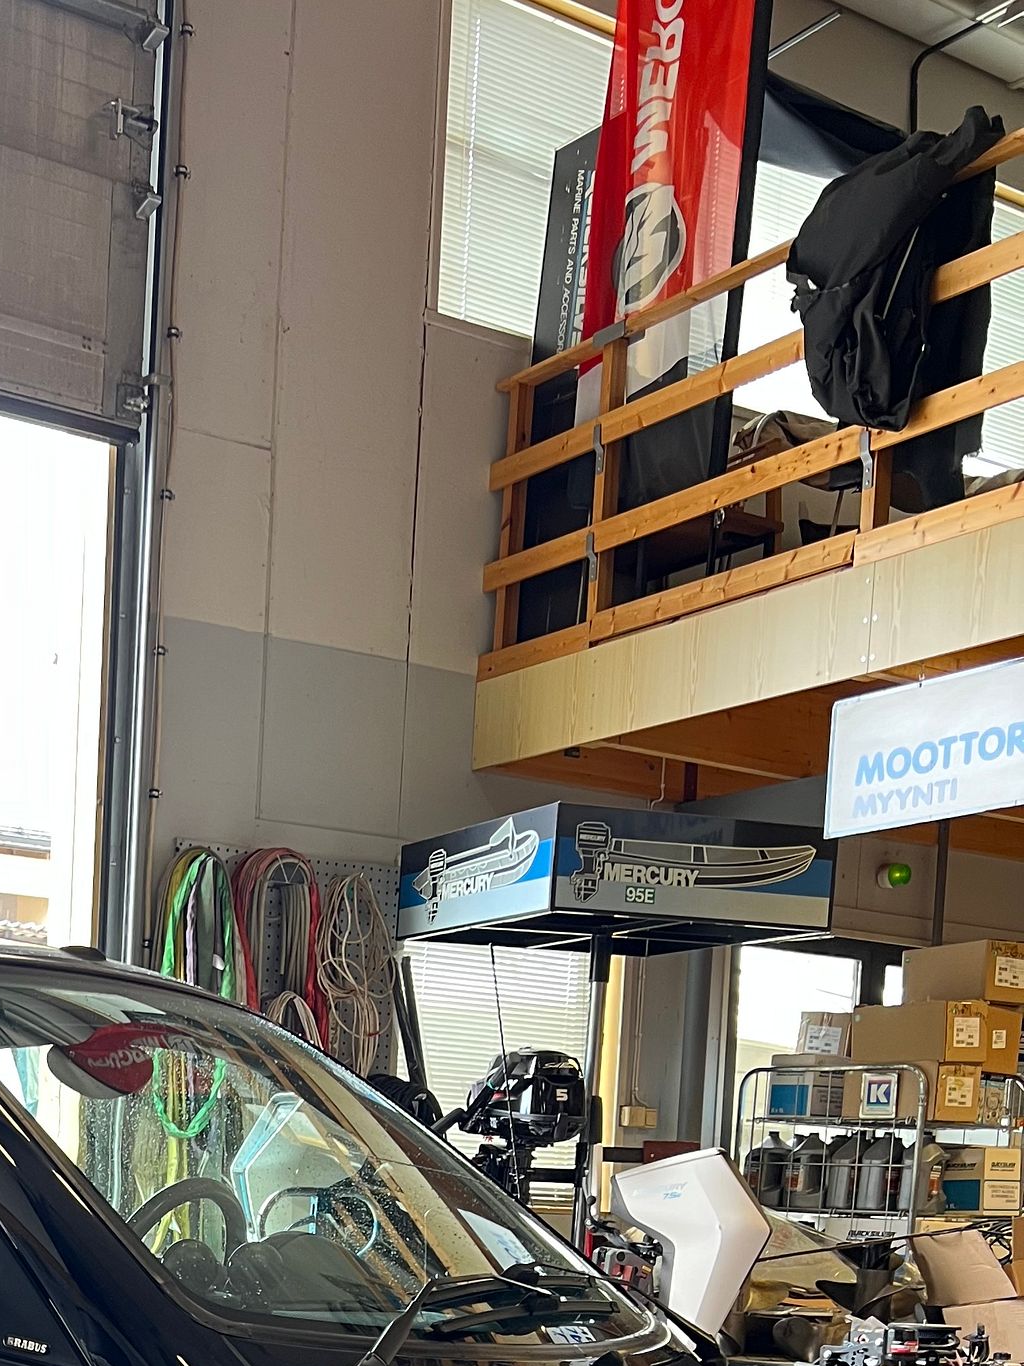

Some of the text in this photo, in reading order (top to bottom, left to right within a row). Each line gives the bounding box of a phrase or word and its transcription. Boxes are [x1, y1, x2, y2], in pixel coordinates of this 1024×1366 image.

[573, 169, 585, 215] MARINE
[568, 217, 579, 255] PARTS
[565, 258, 574, 284] AND
[853, 778, 958, 818] MYYNTI
[442, 872, 495, 898] MERCURY
[603, 862, 699, 888] MERCURY
[626, 887, 655, 903] 95E
[555, 1088, 568, 1101] 5
[870, 1083, 888, 1103] K
[6, 1336, 48, 1354] BRABUS
